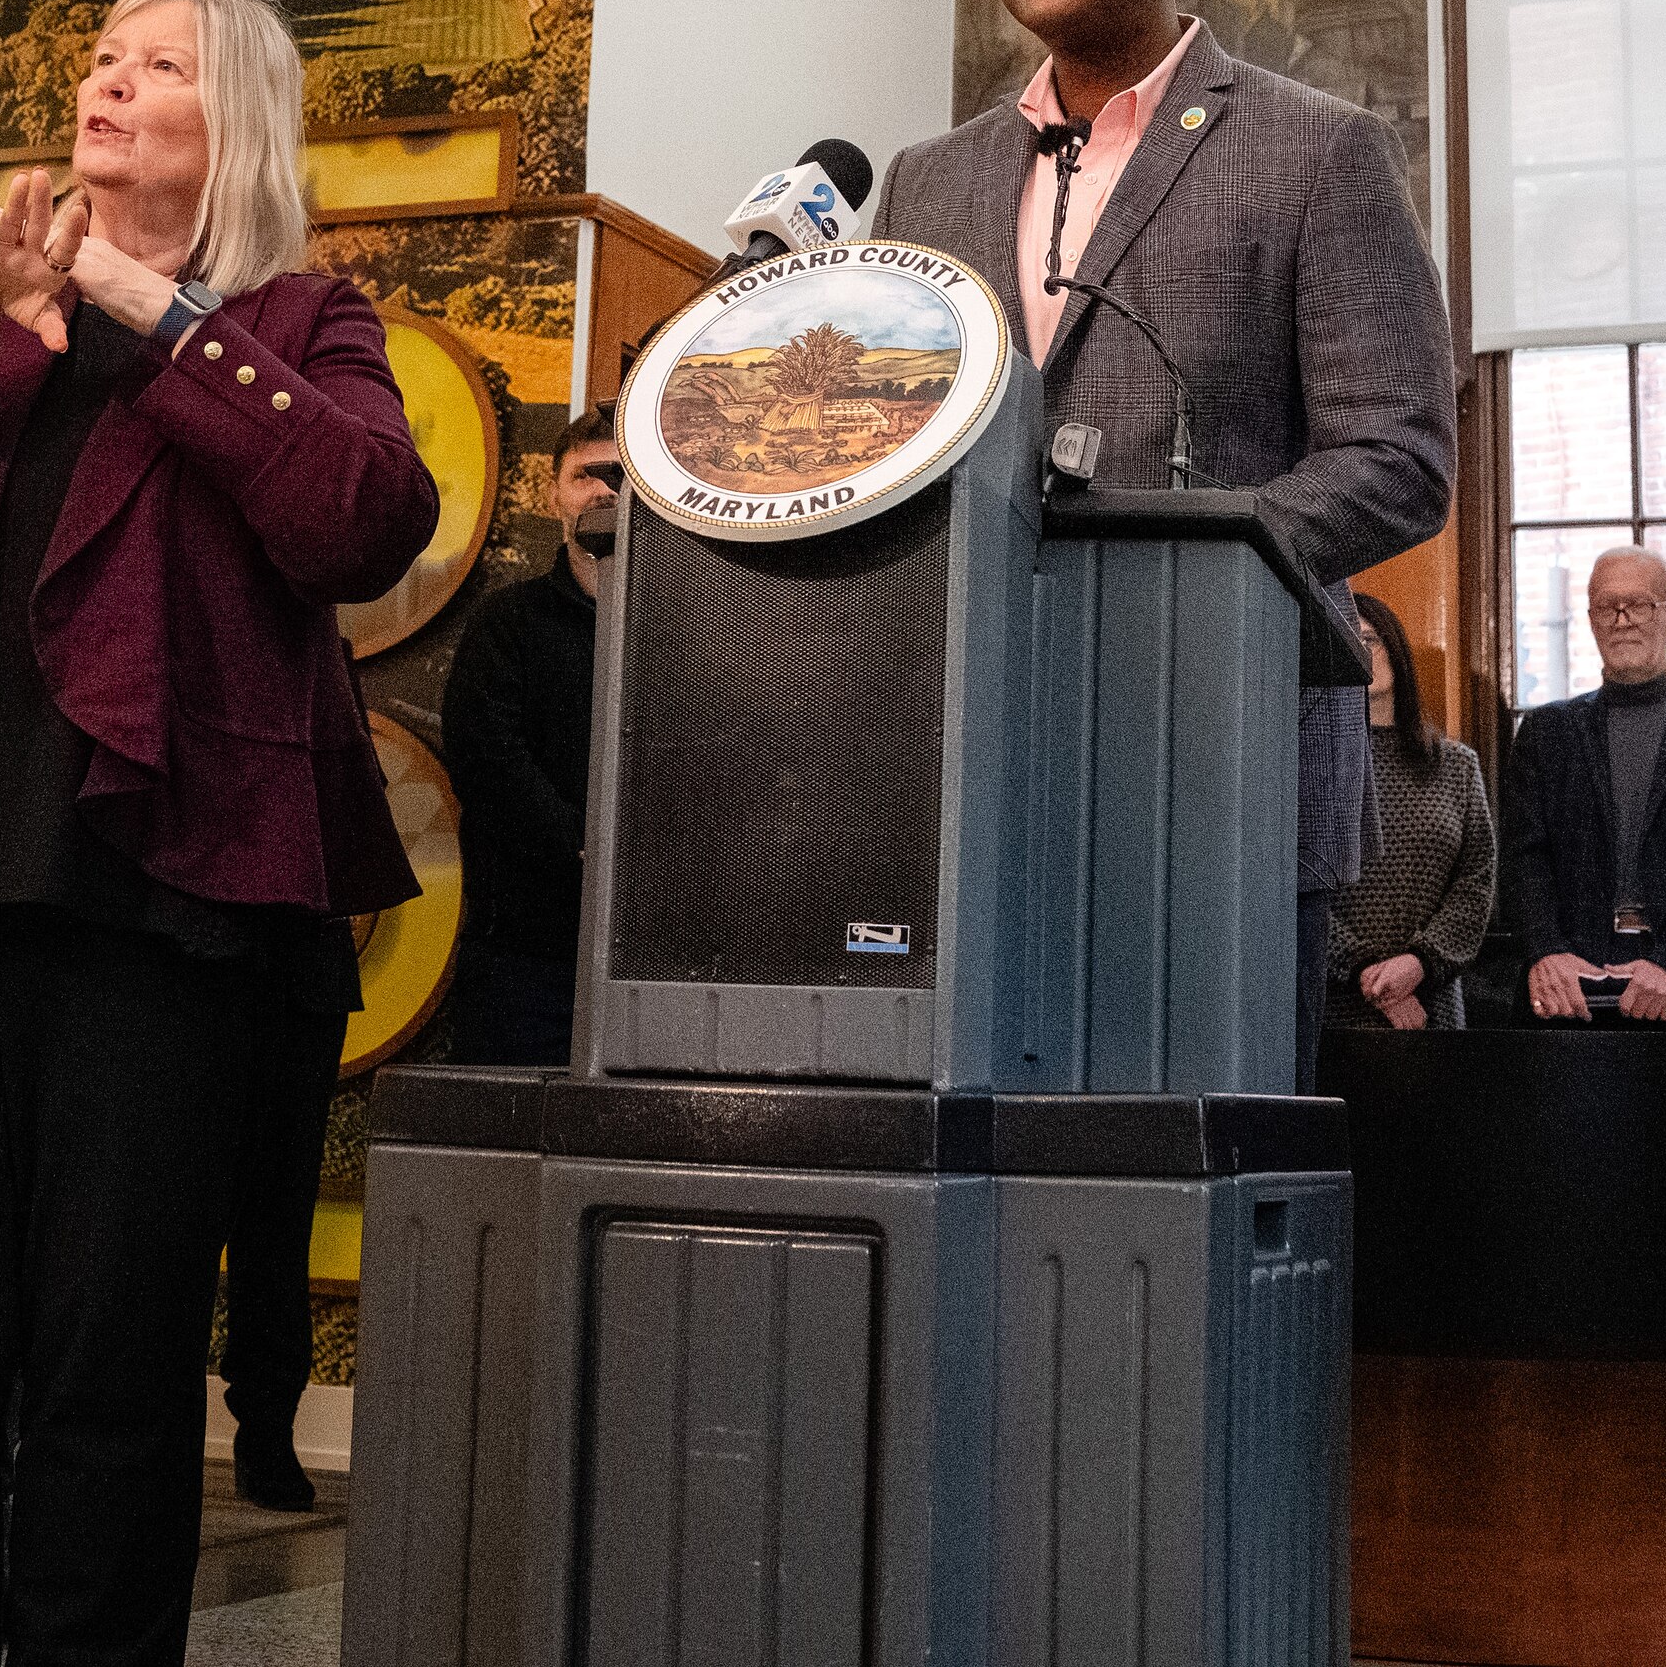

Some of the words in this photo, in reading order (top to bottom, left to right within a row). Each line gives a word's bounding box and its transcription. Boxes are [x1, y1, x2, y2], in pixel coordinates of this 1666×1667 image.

[798, 182, 836, 232] 2
[787, 216, 813, 249] NEW
[822, 219, 838, 239] abc
[715, 248, 850, 306] HOWARD
[858, 246, 967, 289] COUNTY
[676, 486, 856, 520] MARYLAND
